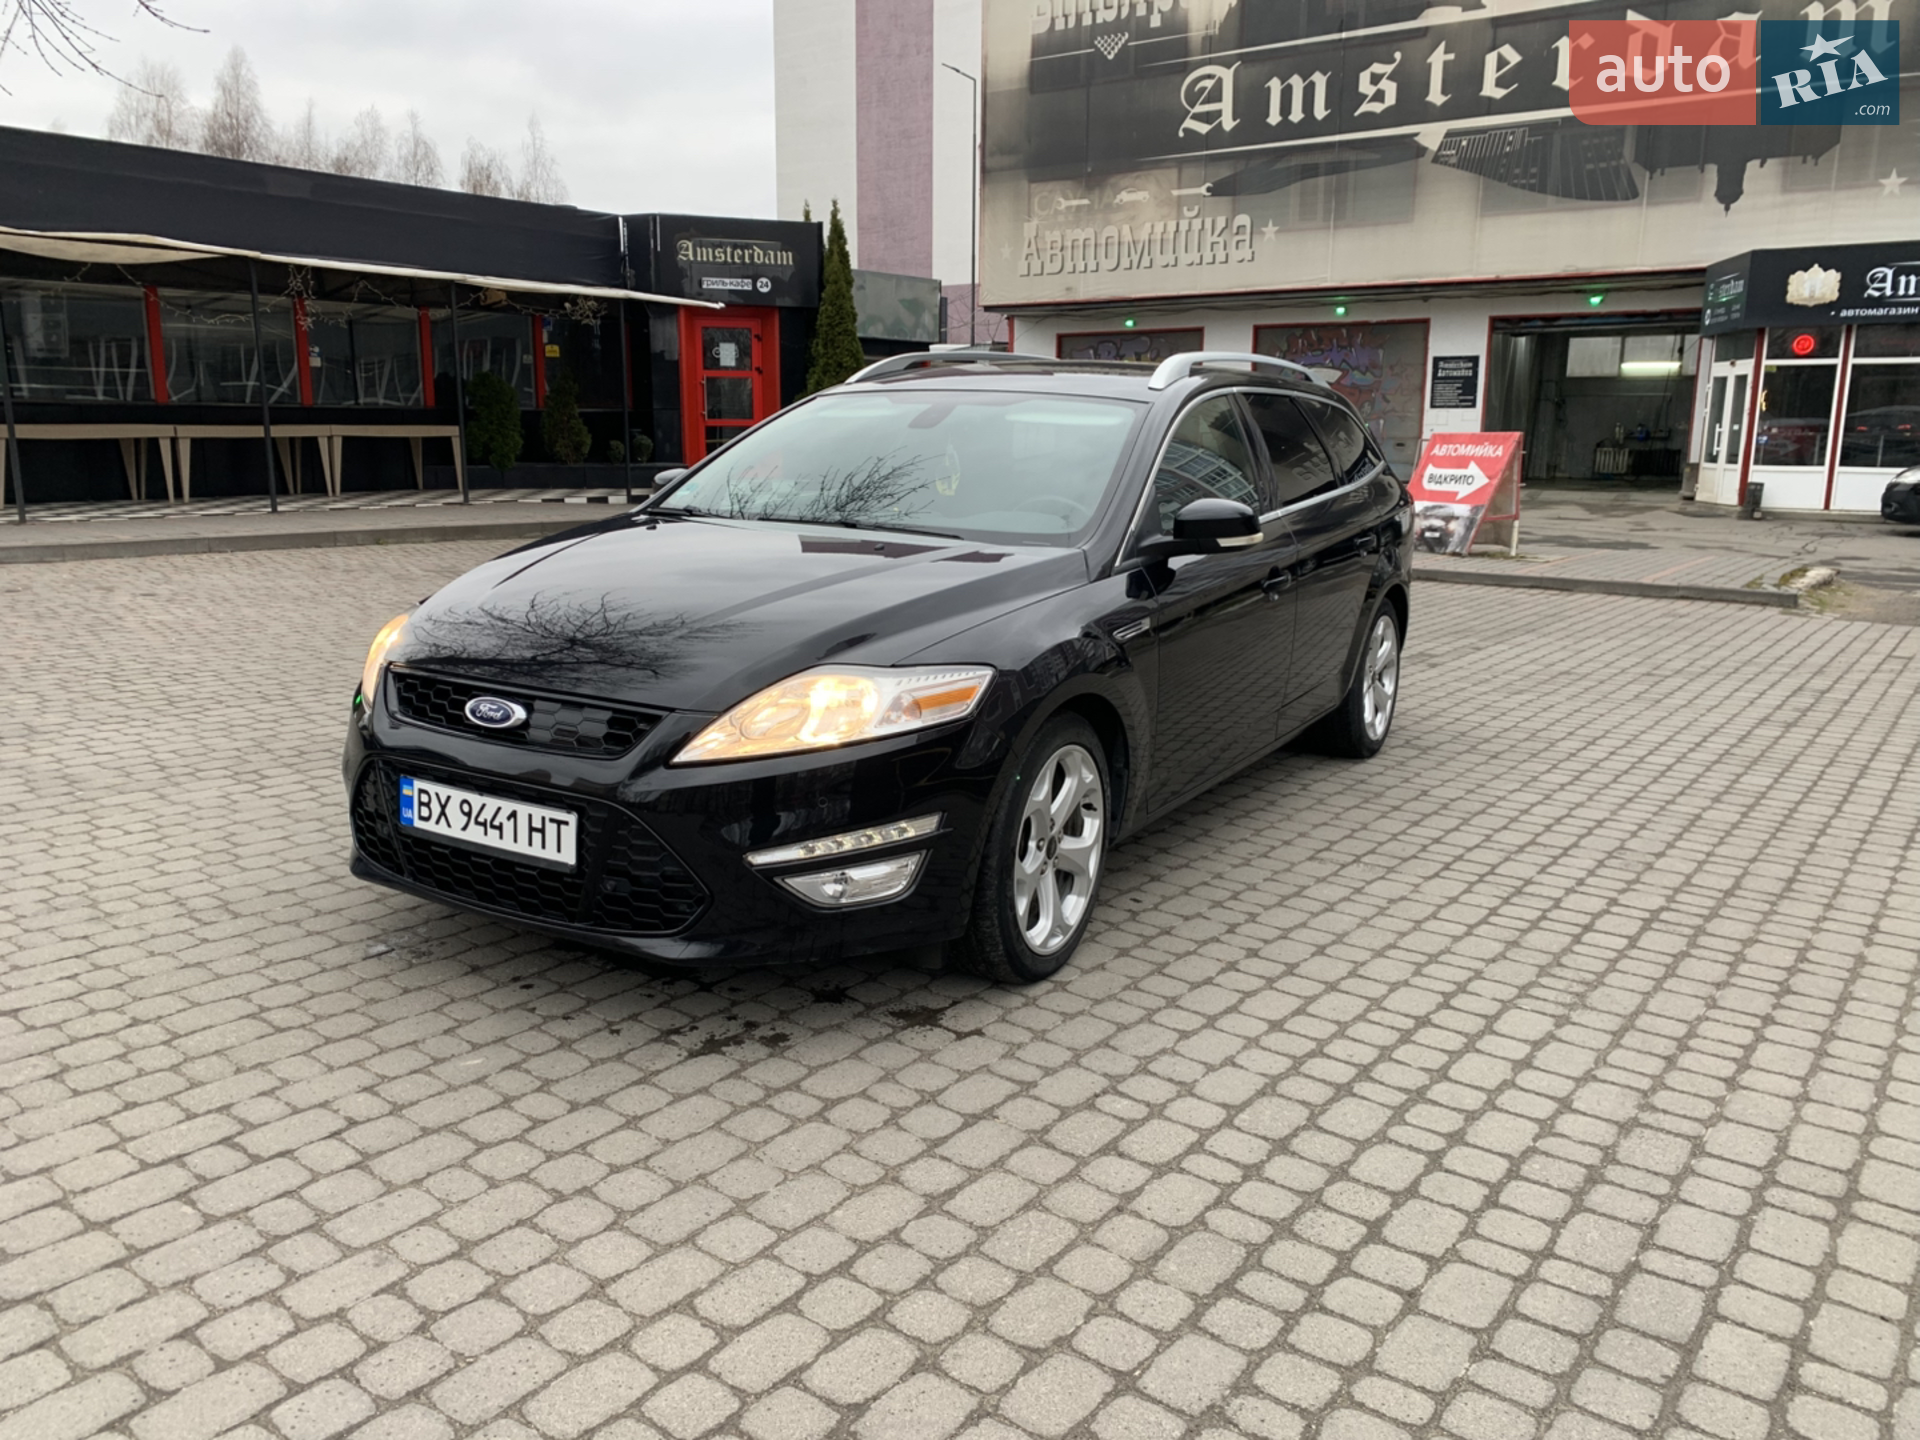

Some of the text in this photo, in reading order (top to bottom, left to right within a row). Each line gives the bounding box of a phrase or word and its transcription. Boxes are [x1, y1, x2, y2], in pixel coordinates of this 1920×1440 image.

[1178, 0, 1897, 138] Amsterdam
[1019, 205, 1256, 278] Автомийка
[676, 239, 794, 266] Amsterdam
[758, 280, 770, 288] 24
[1840, 307, 1920, 318] автомагазин
[1430, 442, 1503, 457] АВТОМИЙКА
[1427, 472, 1475, 486] ВІДКРИТО
[475, 703, 504, 720] Ford
[402, 807, 413, 819] UA
[417, 788, 570, 854] BX 9441 HT
